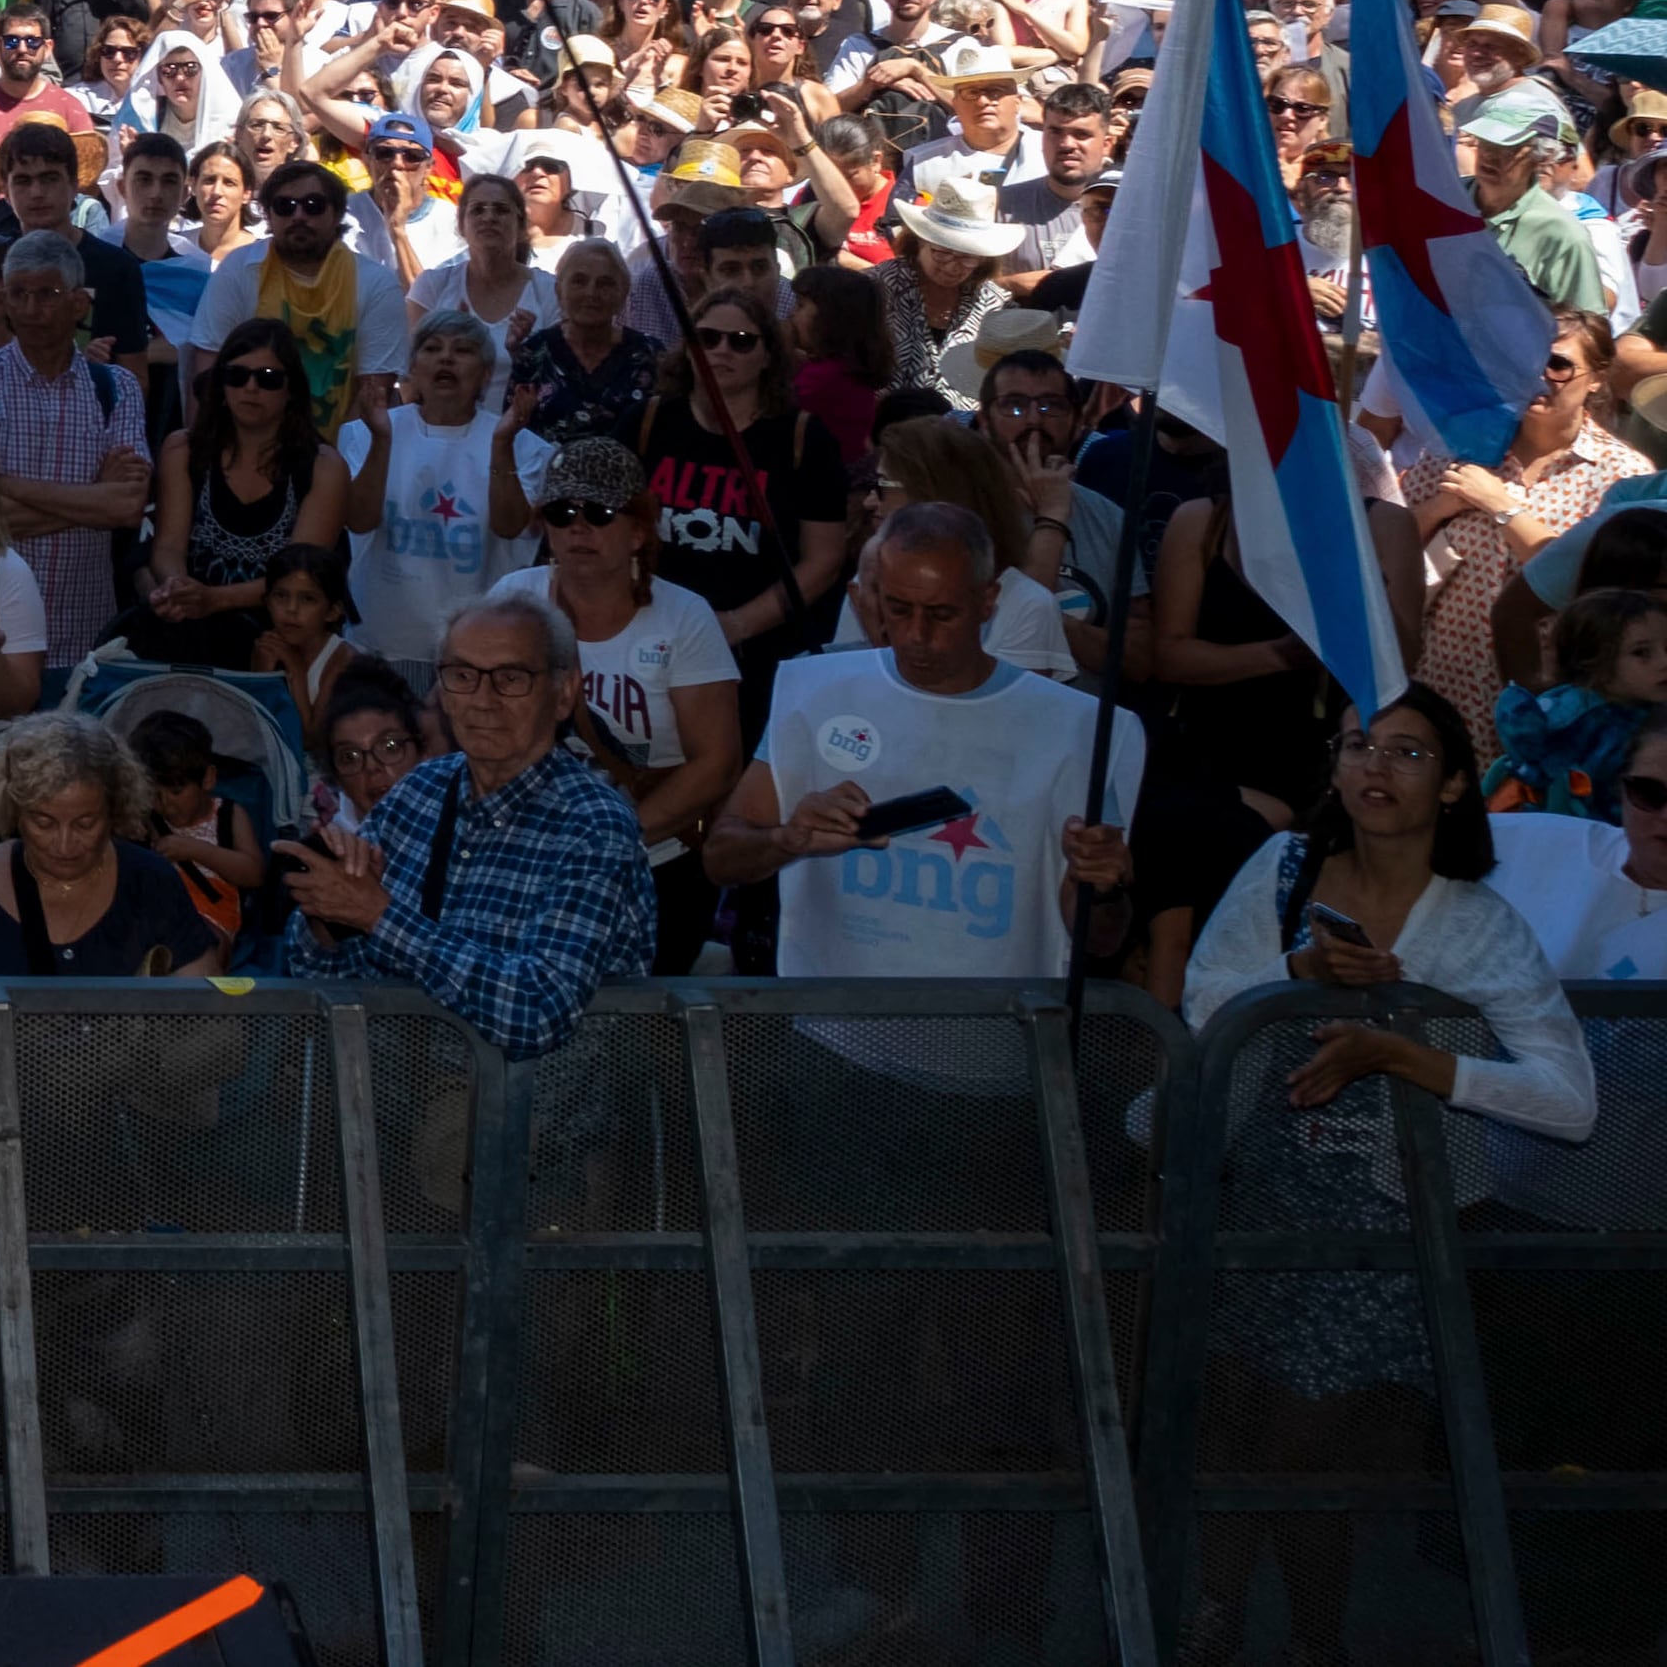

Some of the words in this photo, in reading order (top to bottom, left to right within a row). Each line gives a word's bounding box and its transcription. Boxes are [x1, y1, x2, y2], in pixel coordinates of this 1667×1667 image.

[385, 501, 482, 575] bng
[638, 646, 671, 670] bng
[827, 728, 872, 763] bng
[842, 844, 1015, 939] bng
